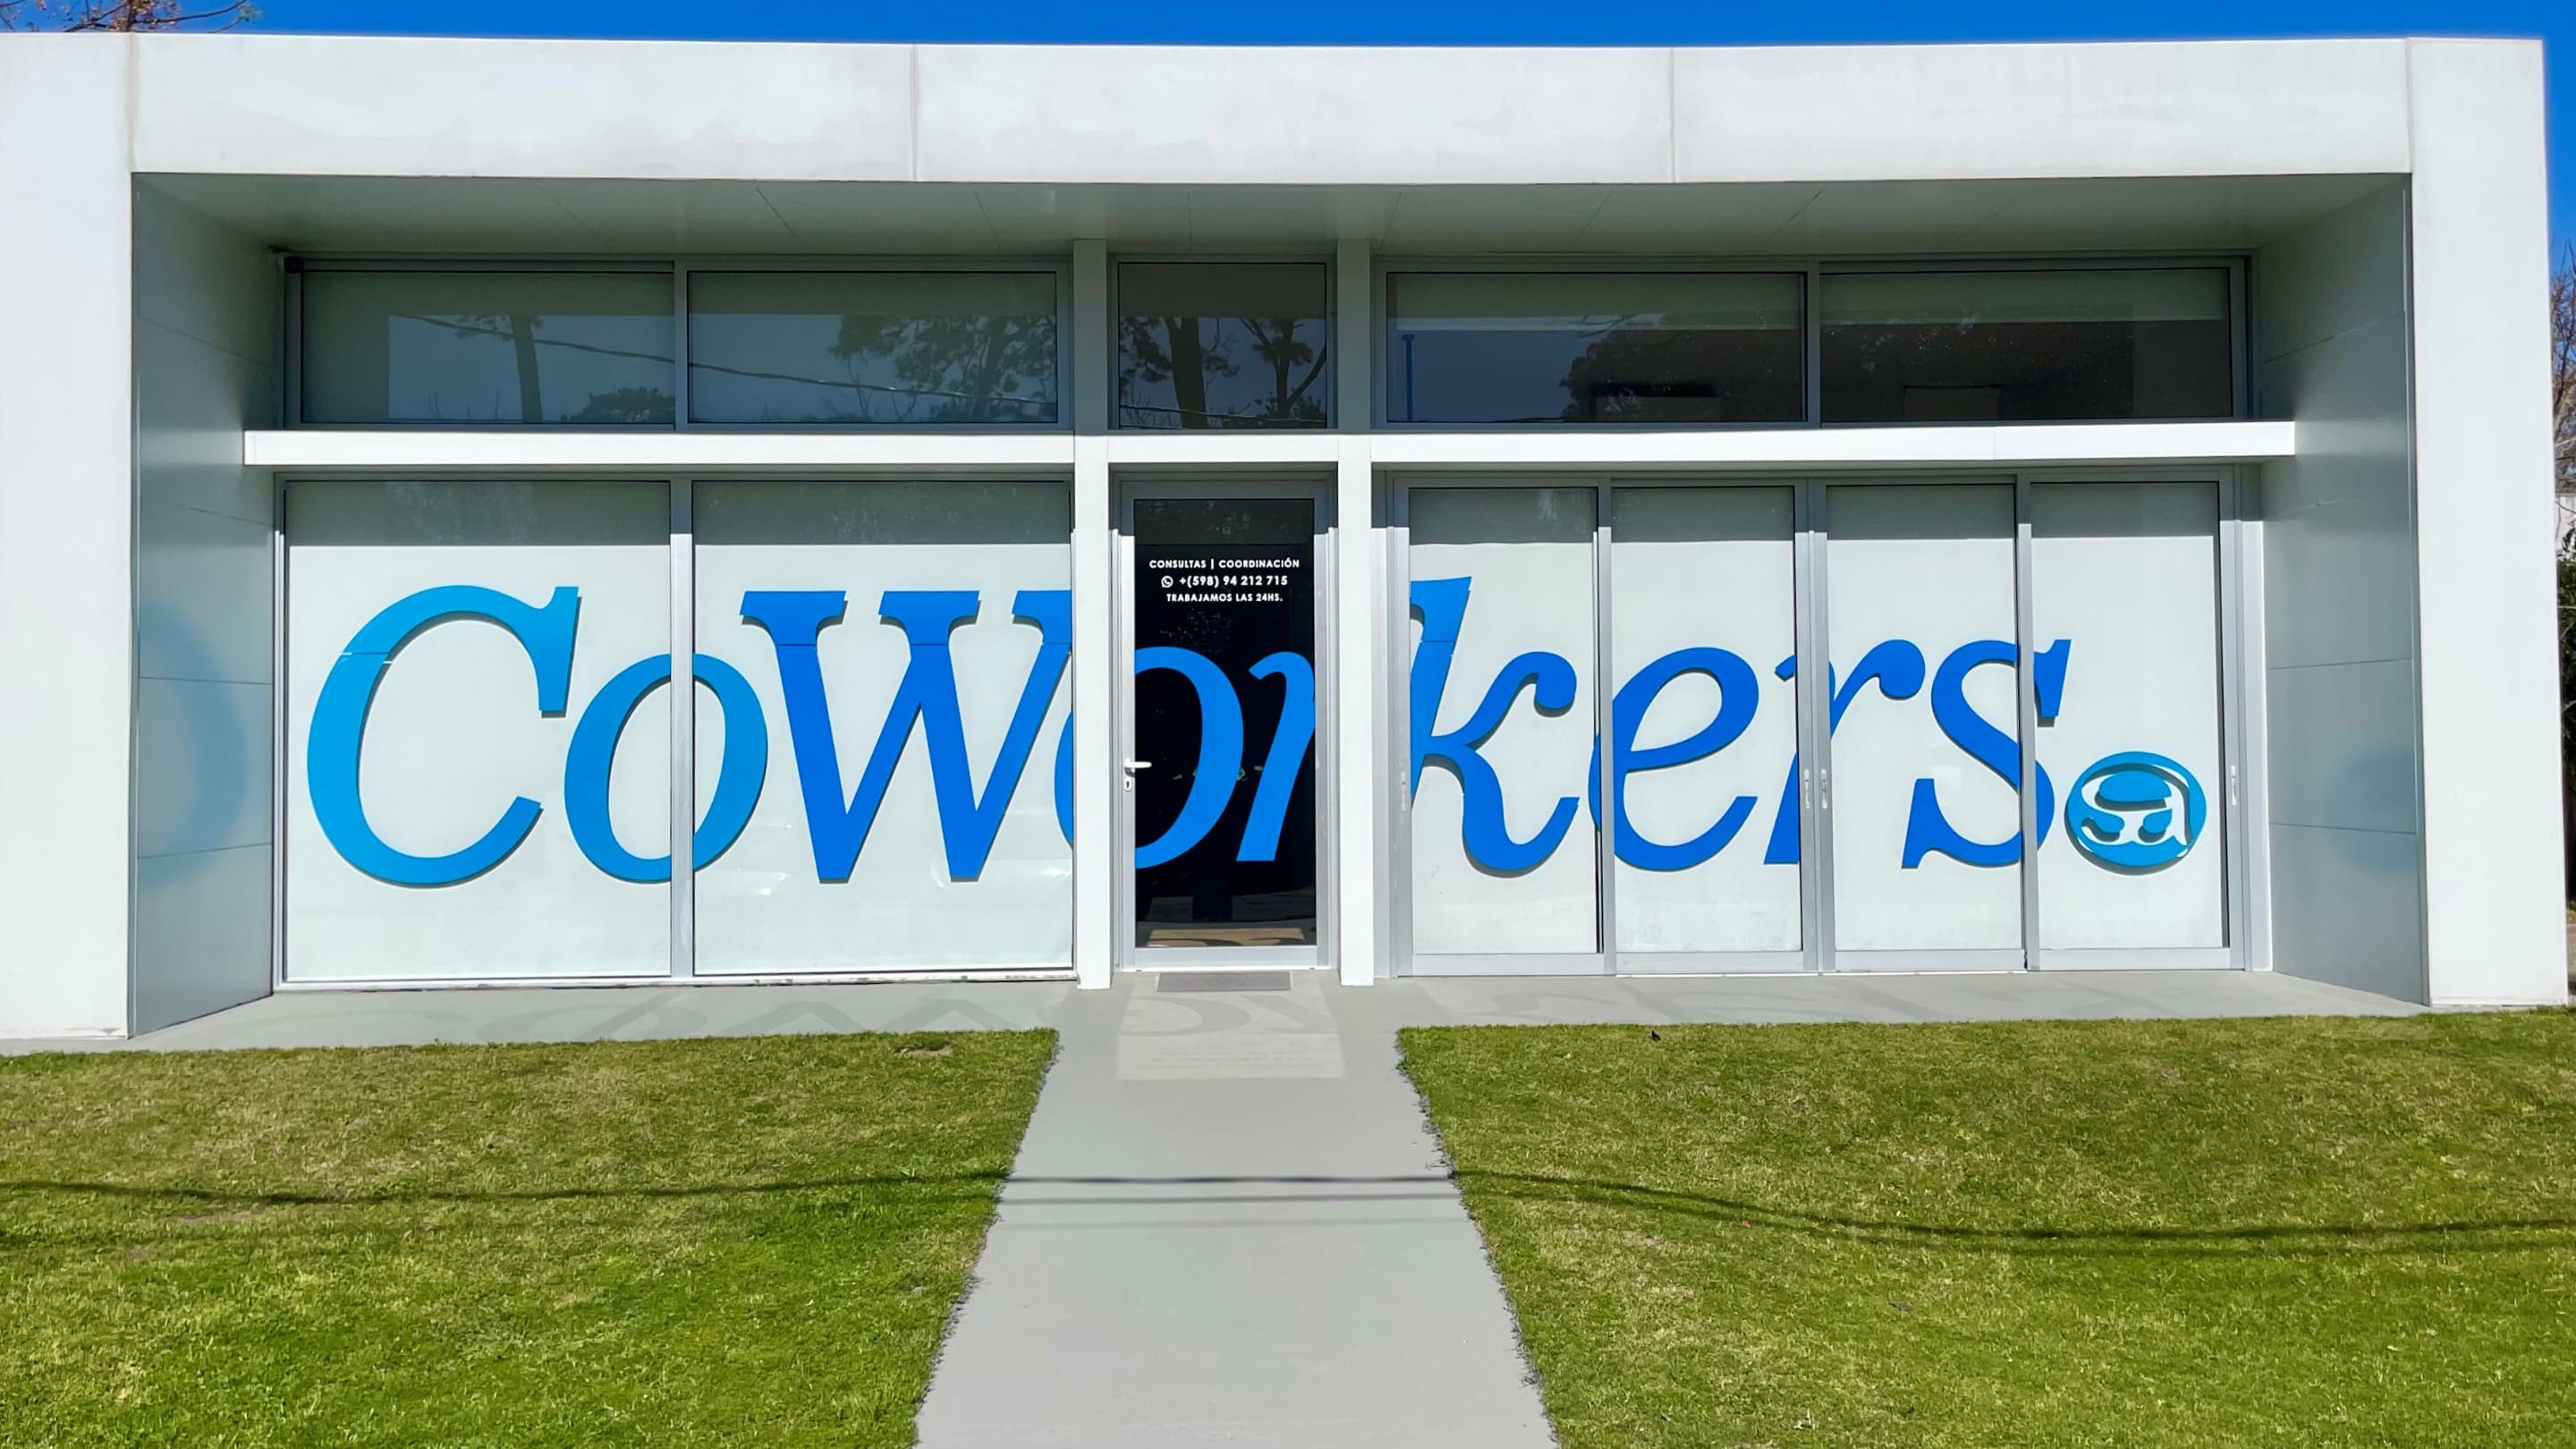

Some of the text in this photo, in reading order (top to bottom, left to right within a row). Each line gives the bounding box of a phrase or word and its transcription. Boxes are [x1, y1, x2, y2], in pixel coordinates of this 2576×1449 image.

[1148, 559, 1207, 569] CONSULTAS
[1218, 556, 1300, 569] COORDINACIÓN
[1179, 575, 1288, 589] +(598) 94 212 715
[1165, 593, 1284, 602] TRABAJAMOS LAS 24HS.
